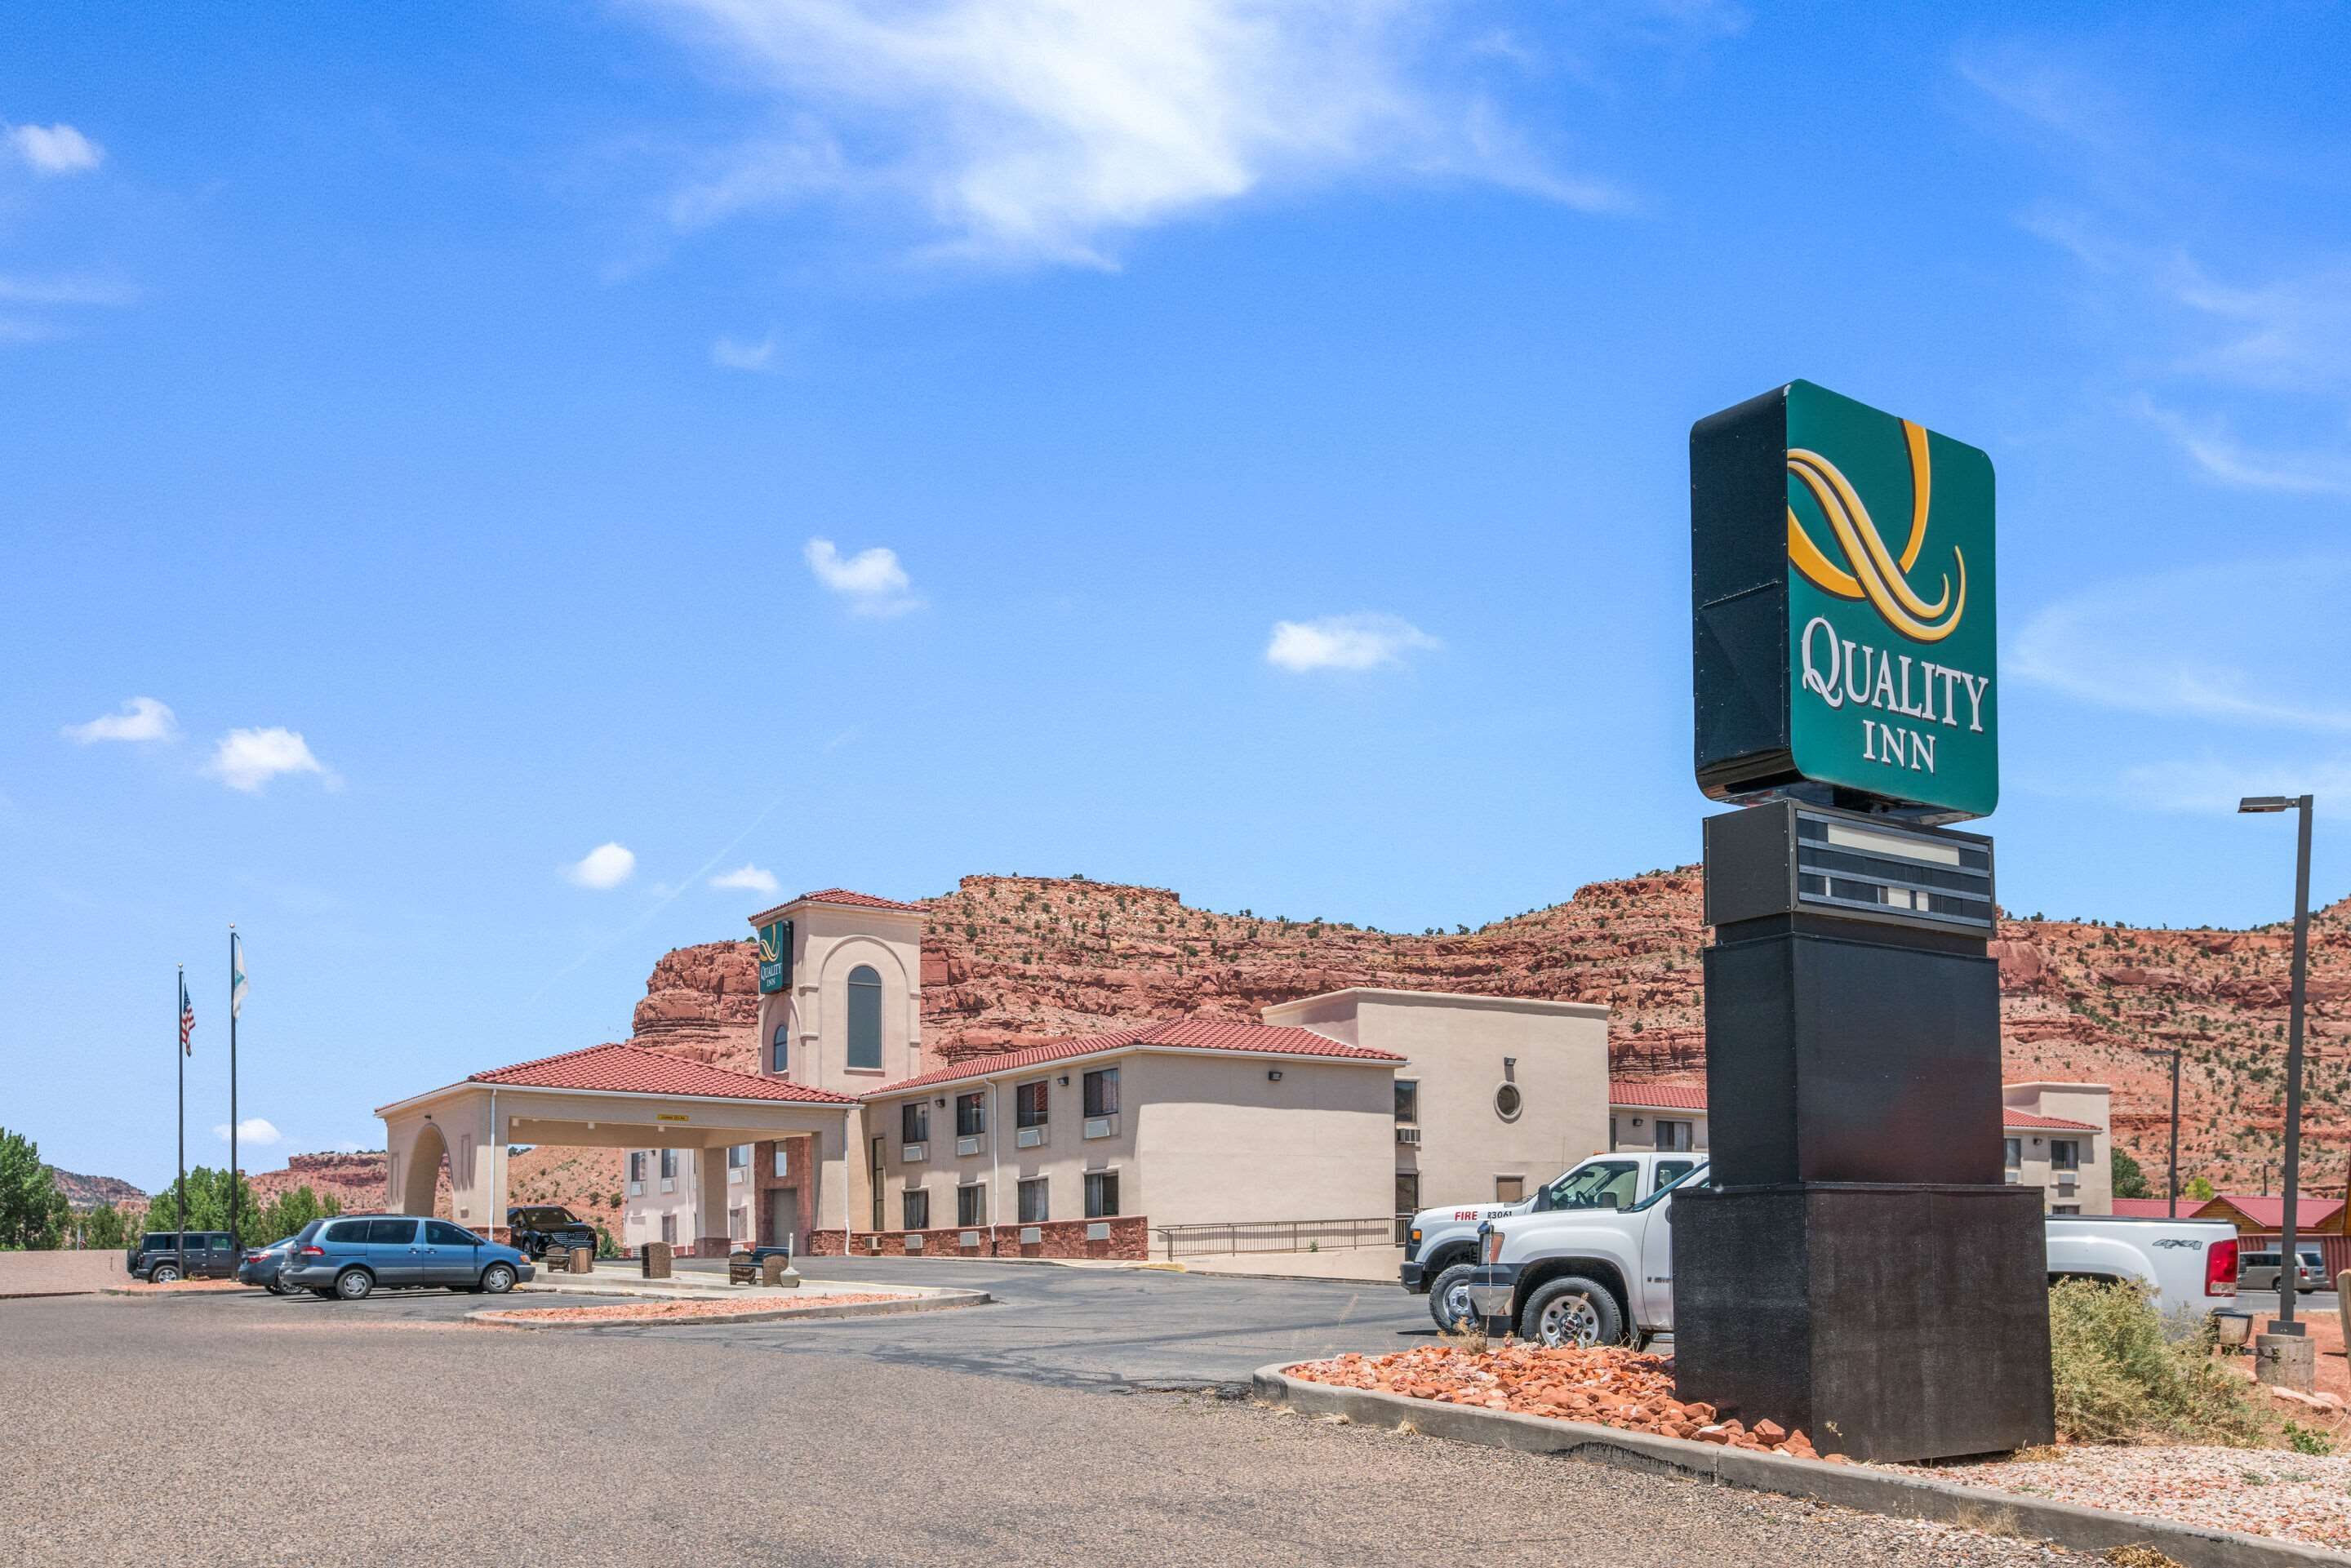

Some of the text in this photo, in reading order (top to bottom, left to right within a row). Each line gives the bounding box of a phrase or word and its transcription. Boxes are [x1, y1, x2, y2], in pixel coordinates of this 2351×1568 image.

[1802, 617, 1989, 732] QUALITY
[1863, 720, 1935, 774] INN
[761, 963, 782, 980] QUALITY
[767, 978, 776, 986] INN
[1455, 1210, 1478, 1221] FIRE
